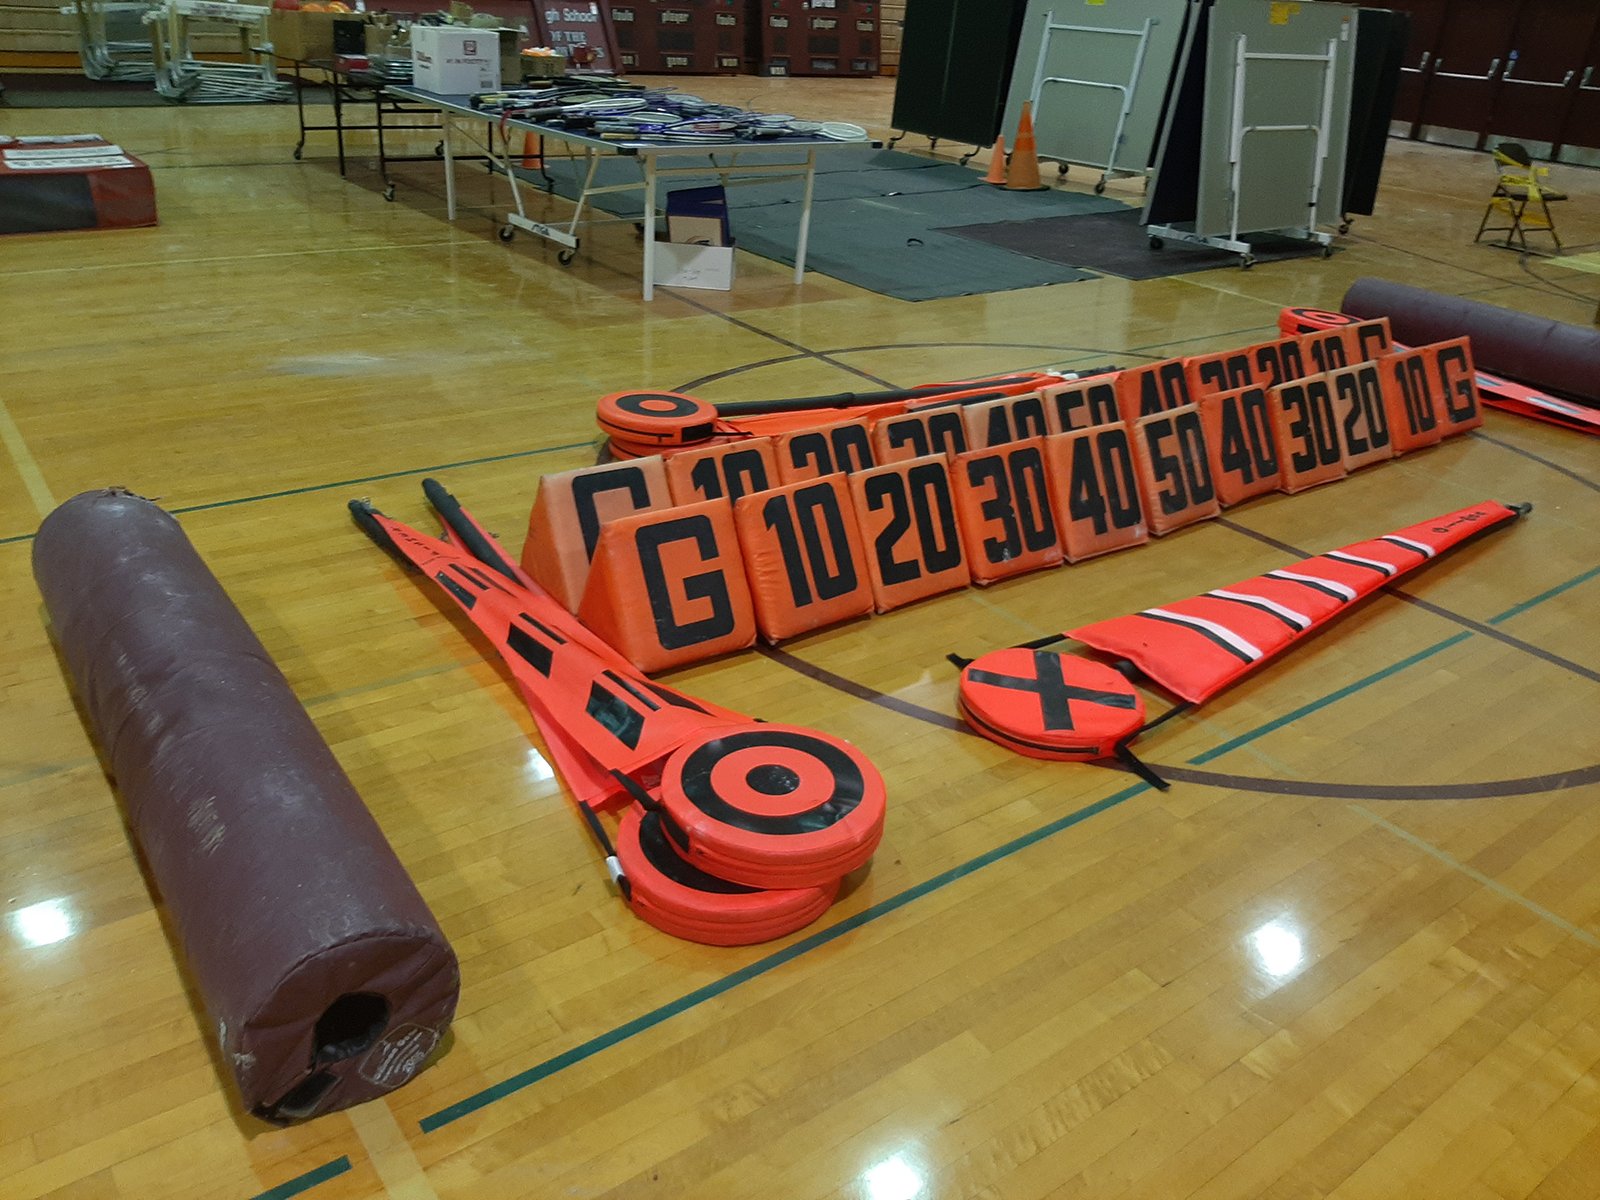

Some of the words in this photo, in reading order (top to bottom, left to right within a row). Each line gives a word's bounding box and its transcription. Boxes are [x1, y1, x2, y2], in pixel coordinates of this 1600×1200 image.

[635, 514, 735, 651] G
[763, 482, 859, 608] 10
[865, 462, 962, 586] 20
[966, 446, 1057, 563] 30
[1069, 428, 1142, 536] 40
[1144, 411, 1215, 516] 50
[1221, 387, 1280, 485] 40
[1280, 381, 1342, 474] 30
[1335, 366, 1389, 457] 20
[1395, 355, 1437, 436] 10
[1437, 344, 1477, 424] G
